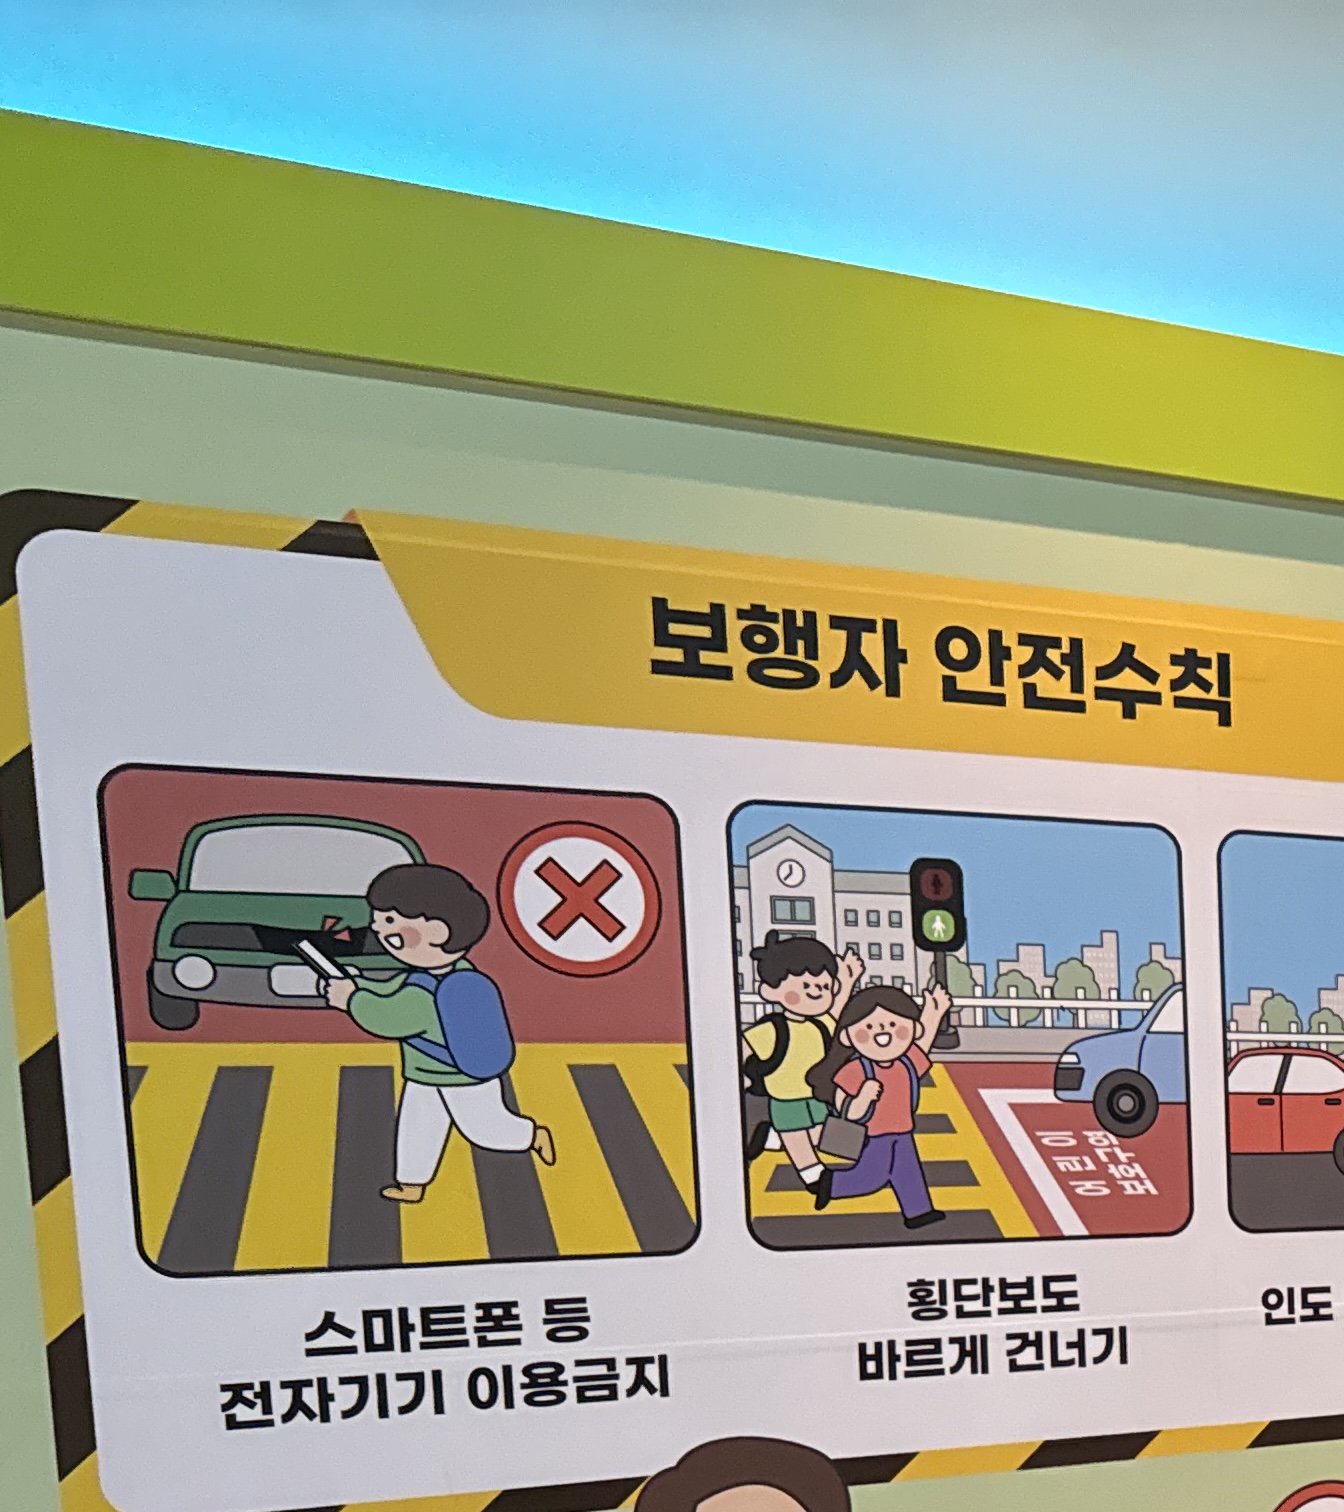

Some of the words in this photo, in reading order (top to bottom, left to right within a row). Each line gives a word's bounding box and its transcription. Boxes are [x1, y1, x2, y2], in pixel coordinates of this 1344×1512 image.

[650, 596, 908, 699] 보행자
[934, 625, 1233, 728] 안전수칙
[304, 1300, 523, 1358] 스마트폰
[542, 1296, 592, 1343] 등
[906, 1273, 1081, 1322] 횡단보도
[1260, 1285, 1334, 1326] 인도
[857, 1334, 989, 1382] 바르게
[1005, 1326, 1130, 1374] 건너기
[219, 1368, 446, 1431] 전자기기
[467, 1354, 670, 1410] 이용금지
